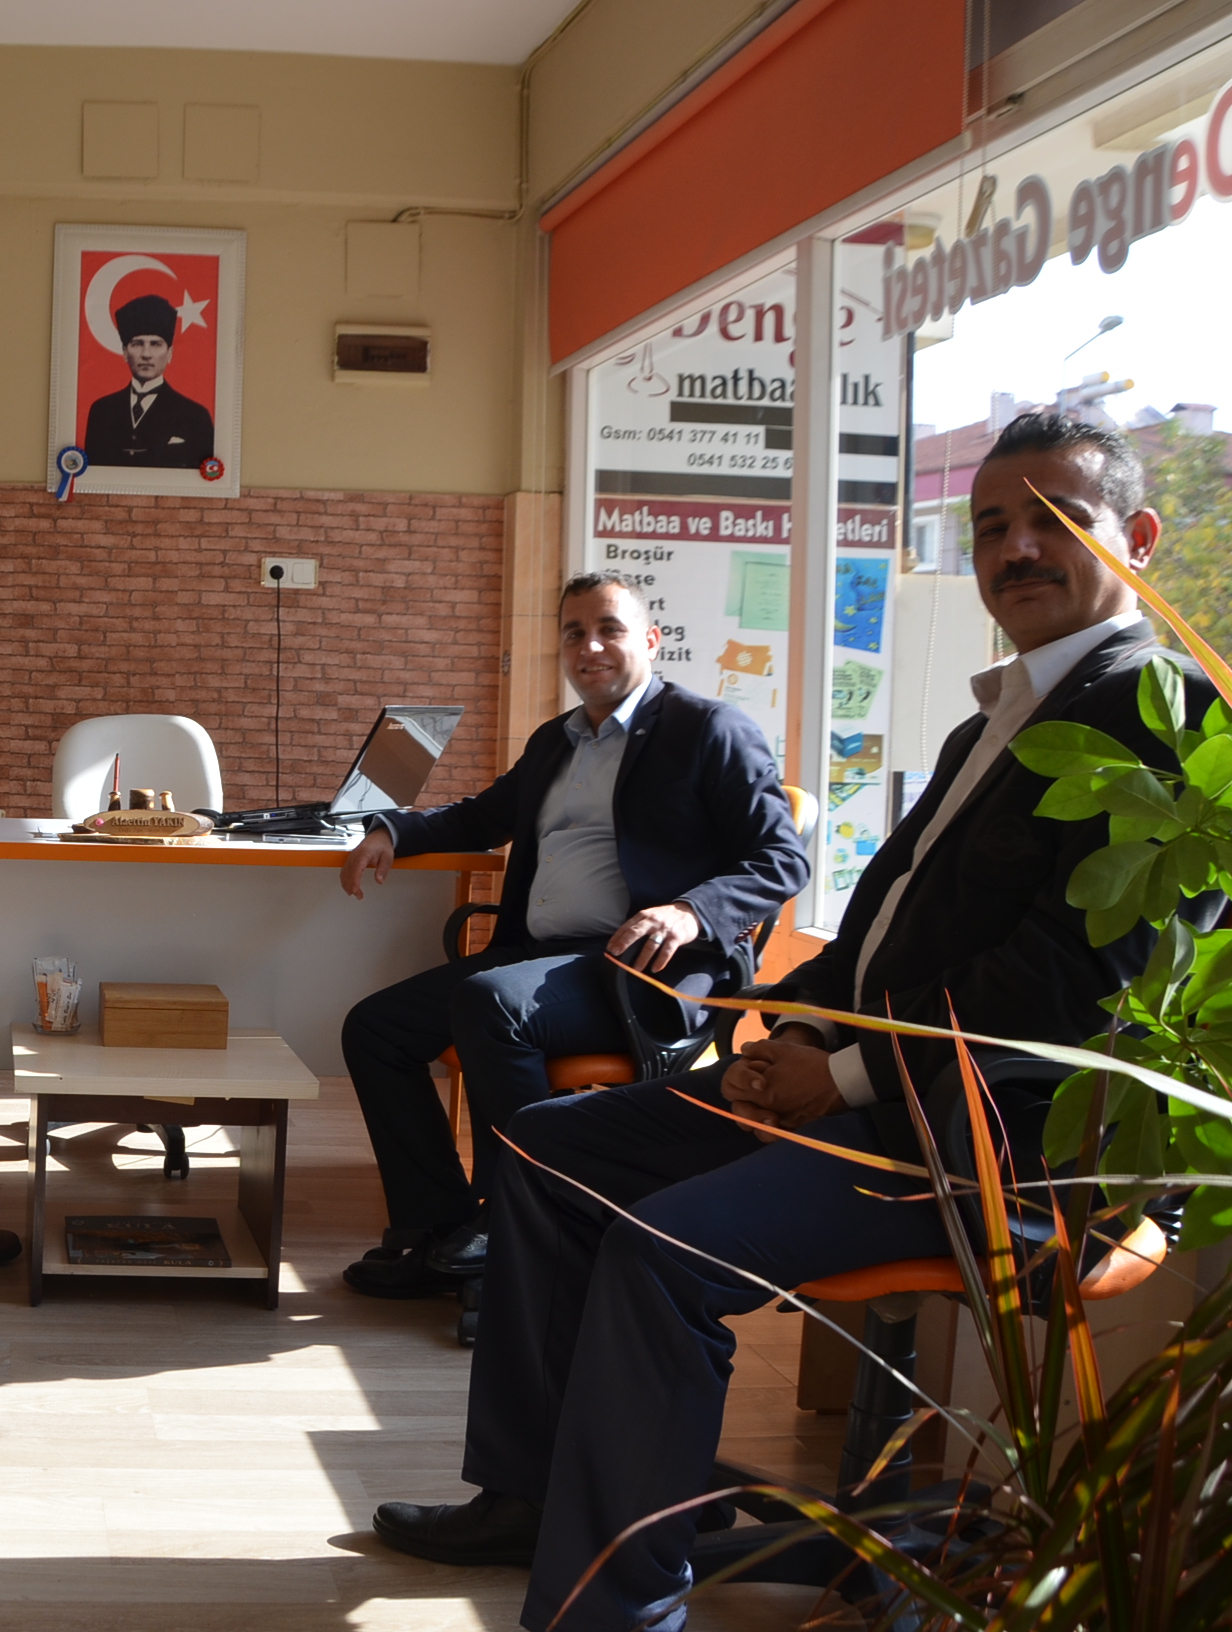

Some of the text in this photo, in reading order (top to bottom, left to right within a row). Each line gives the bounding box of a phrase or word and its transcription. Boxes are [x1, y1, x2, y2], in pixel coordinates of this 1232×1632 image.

[676, 367, 883, 407] matbalık
[600, 425, 761, 445] Gsm: 0541 377 41 11
[686, 452, 723, 467] 0541
[729, 453, 756, 469] 532
[761, 455, 780, 470] 25
[597, 506, 888, 543] Matbaa ve Baskı Hetleri
[605, 544, 674, 565] Broşür
[152, 817, 185, 827] YAKIN
